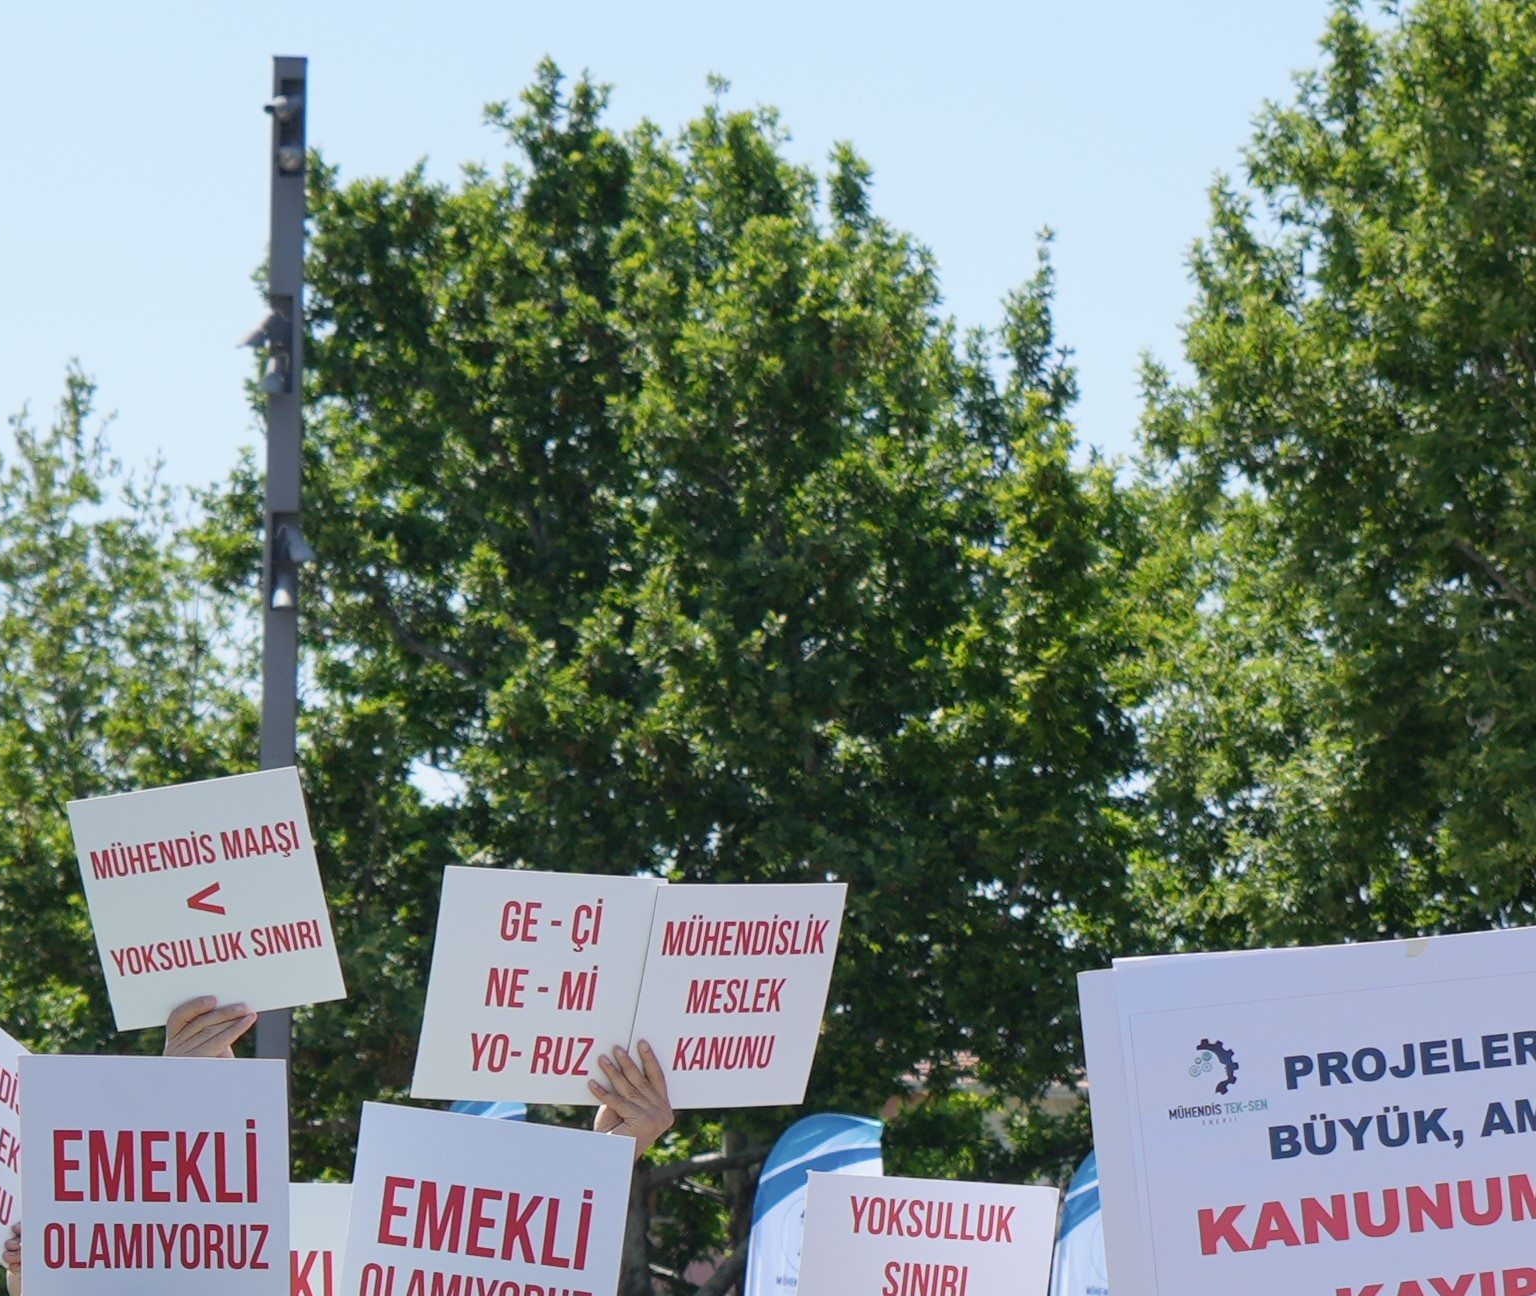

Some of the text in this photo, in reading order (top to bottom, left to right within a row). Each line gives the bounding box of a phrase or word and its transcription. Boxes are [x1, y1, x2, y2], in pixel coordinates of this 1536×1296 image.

[90, 820, 299, 881] MÜHENDİS MAAŞI
[109, 920, 323, 978] YOKSULLUK SINIRI
[661, 914, 830, 957] MÜHENDİSLİK
[685, 978, 787, 1015] MESLEK
[531, 1036, 595, 1077] RUZ
[672, 1034, 777, 1071] KANUNU
[1169, 1099, 1268, 1120] MÜHENDİS TEK-SEN
[1269, 1106, 1465, 1160] BÜYÜK,
[53, 1119, 258, 1204] EMEKLİ
[378, 1175, 593, 1271] EMEKLİ
[850, 1195, 1017, 1244] YOKSULLUK
[43, 1223, 270, 1270] OLAMIYORUZ
